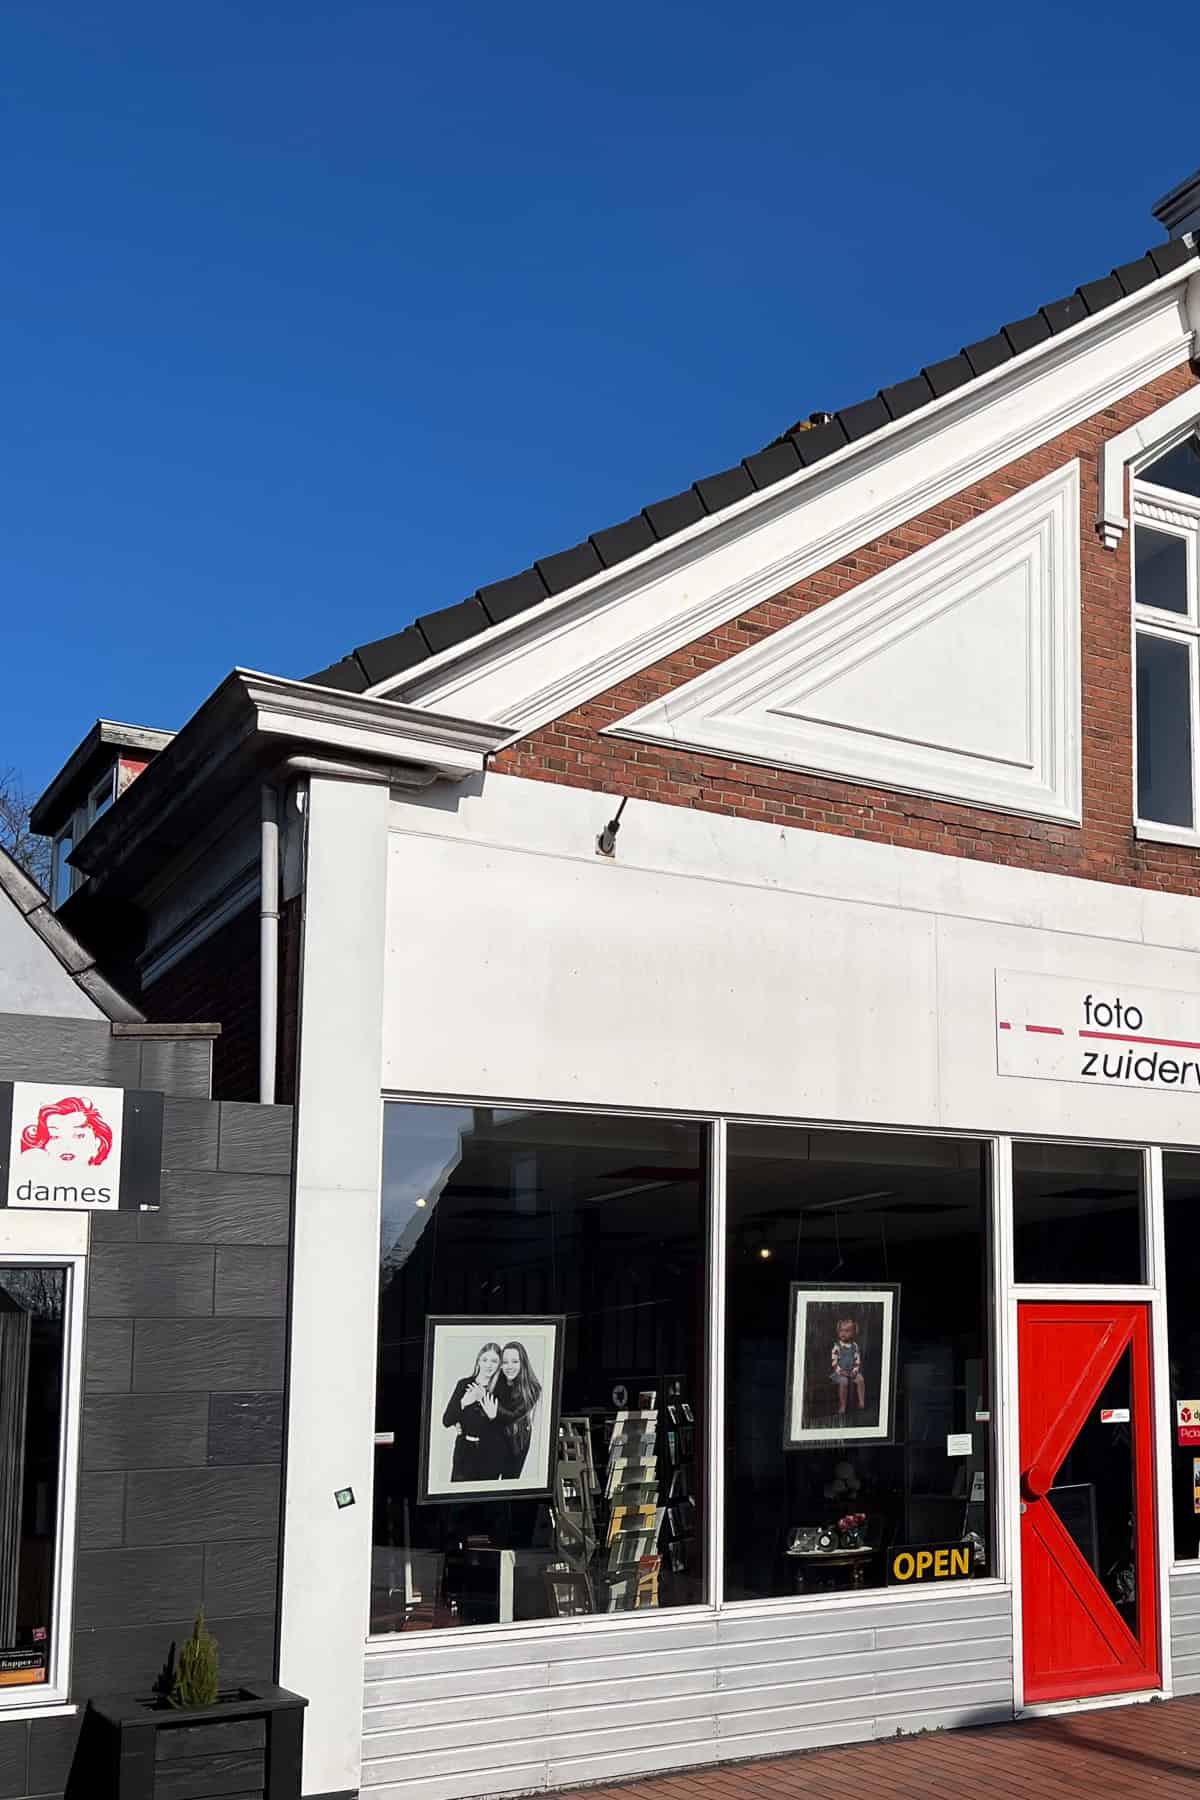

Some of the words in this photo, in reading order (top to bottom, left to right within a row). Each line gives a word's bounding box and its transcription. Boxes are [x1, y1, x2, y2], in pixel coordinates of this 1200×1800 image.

[1083, 995, 1144, 1031] foto
[16, 1179, 112, 1203] dames
[892, 1548, 970, 1581] OPEN
